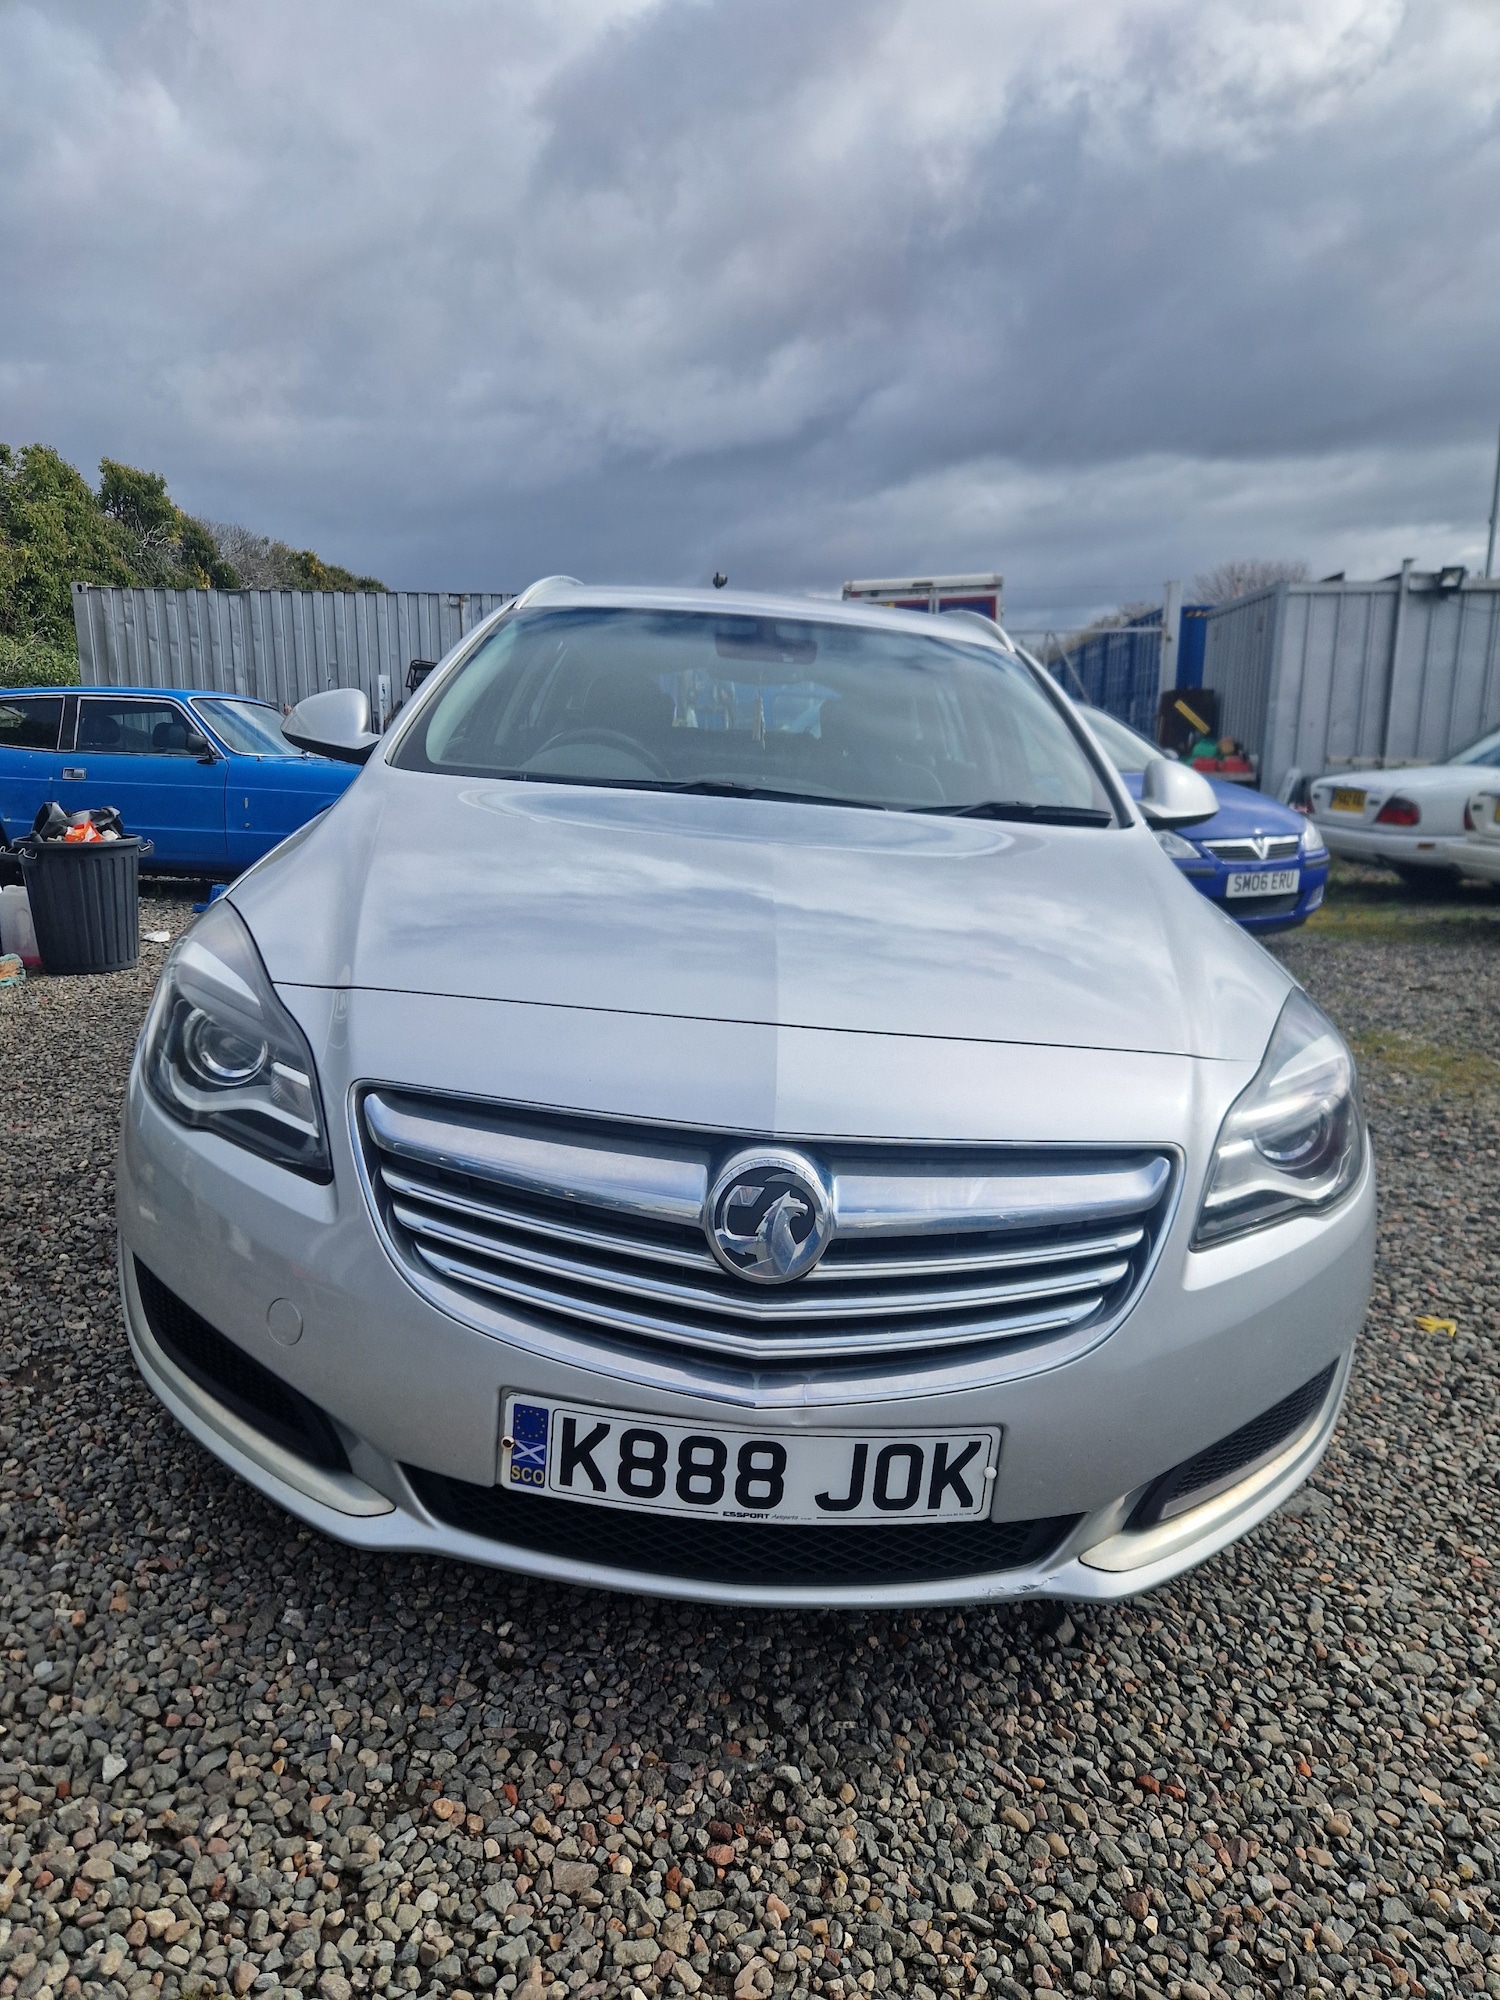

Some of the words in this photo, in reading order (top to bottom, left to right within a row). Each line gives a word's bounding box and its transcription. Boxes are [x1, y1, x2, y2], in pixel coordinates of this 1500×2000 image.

[1233, 874, 1269, 892] SM06
[1270, 871, 1295, 890] ERU
[511, 1465, 545, 1485] SCO
[559, 1417, 788, 1510] K888
[814, 1440, 983, 1513] JOK
[722, 1511, 770, 1519] ESSPORT
